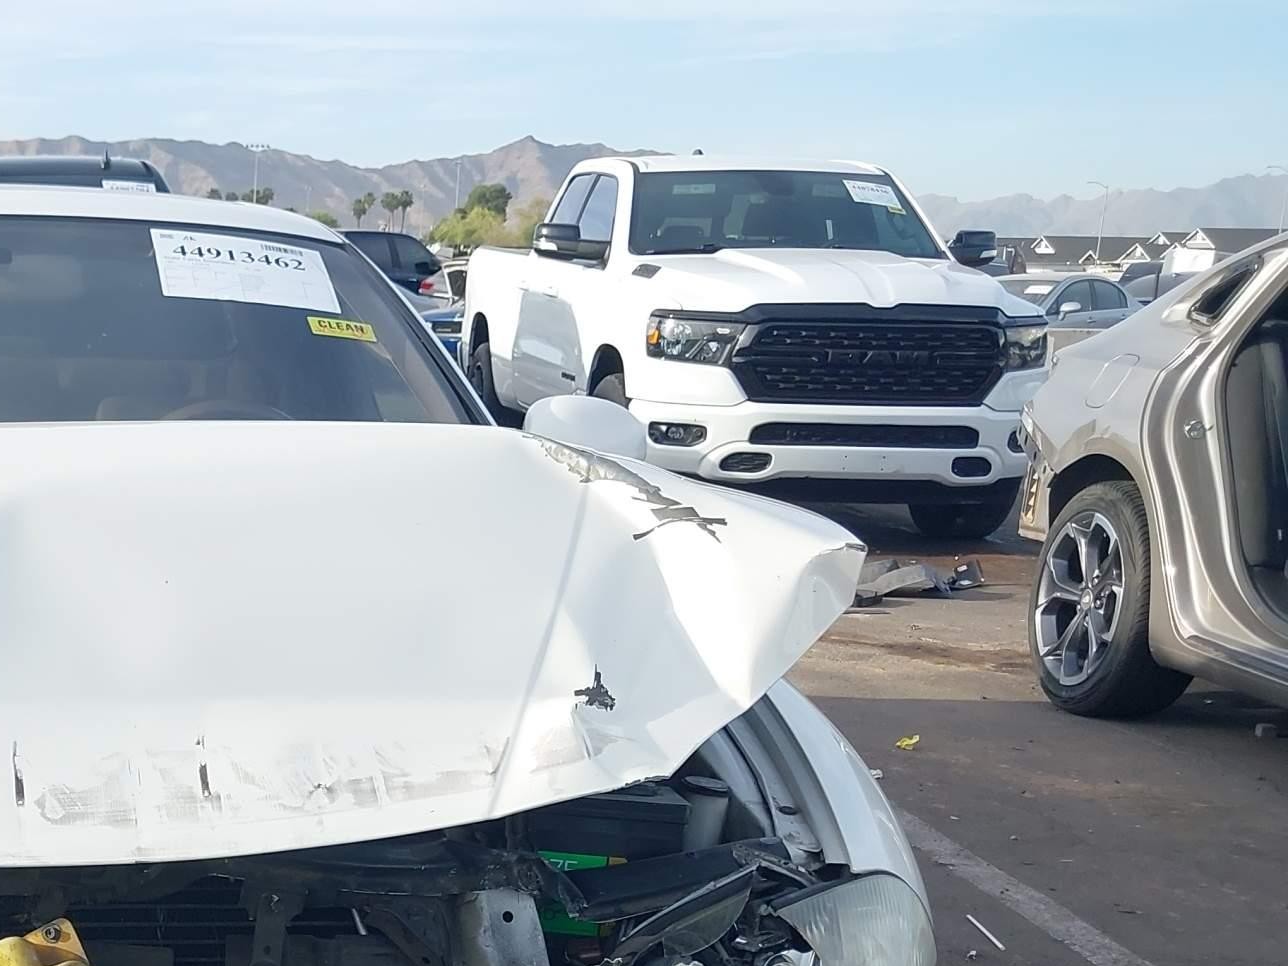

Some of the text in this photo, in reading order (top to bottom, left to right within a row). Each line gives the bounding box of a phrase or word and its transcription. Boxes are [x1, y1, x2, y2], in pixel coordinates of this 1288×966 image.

[173, 244, 306, 271] 44913462
[317, 319, 366, 334] CLEAN
[824, 349, 930, 367] RAM
